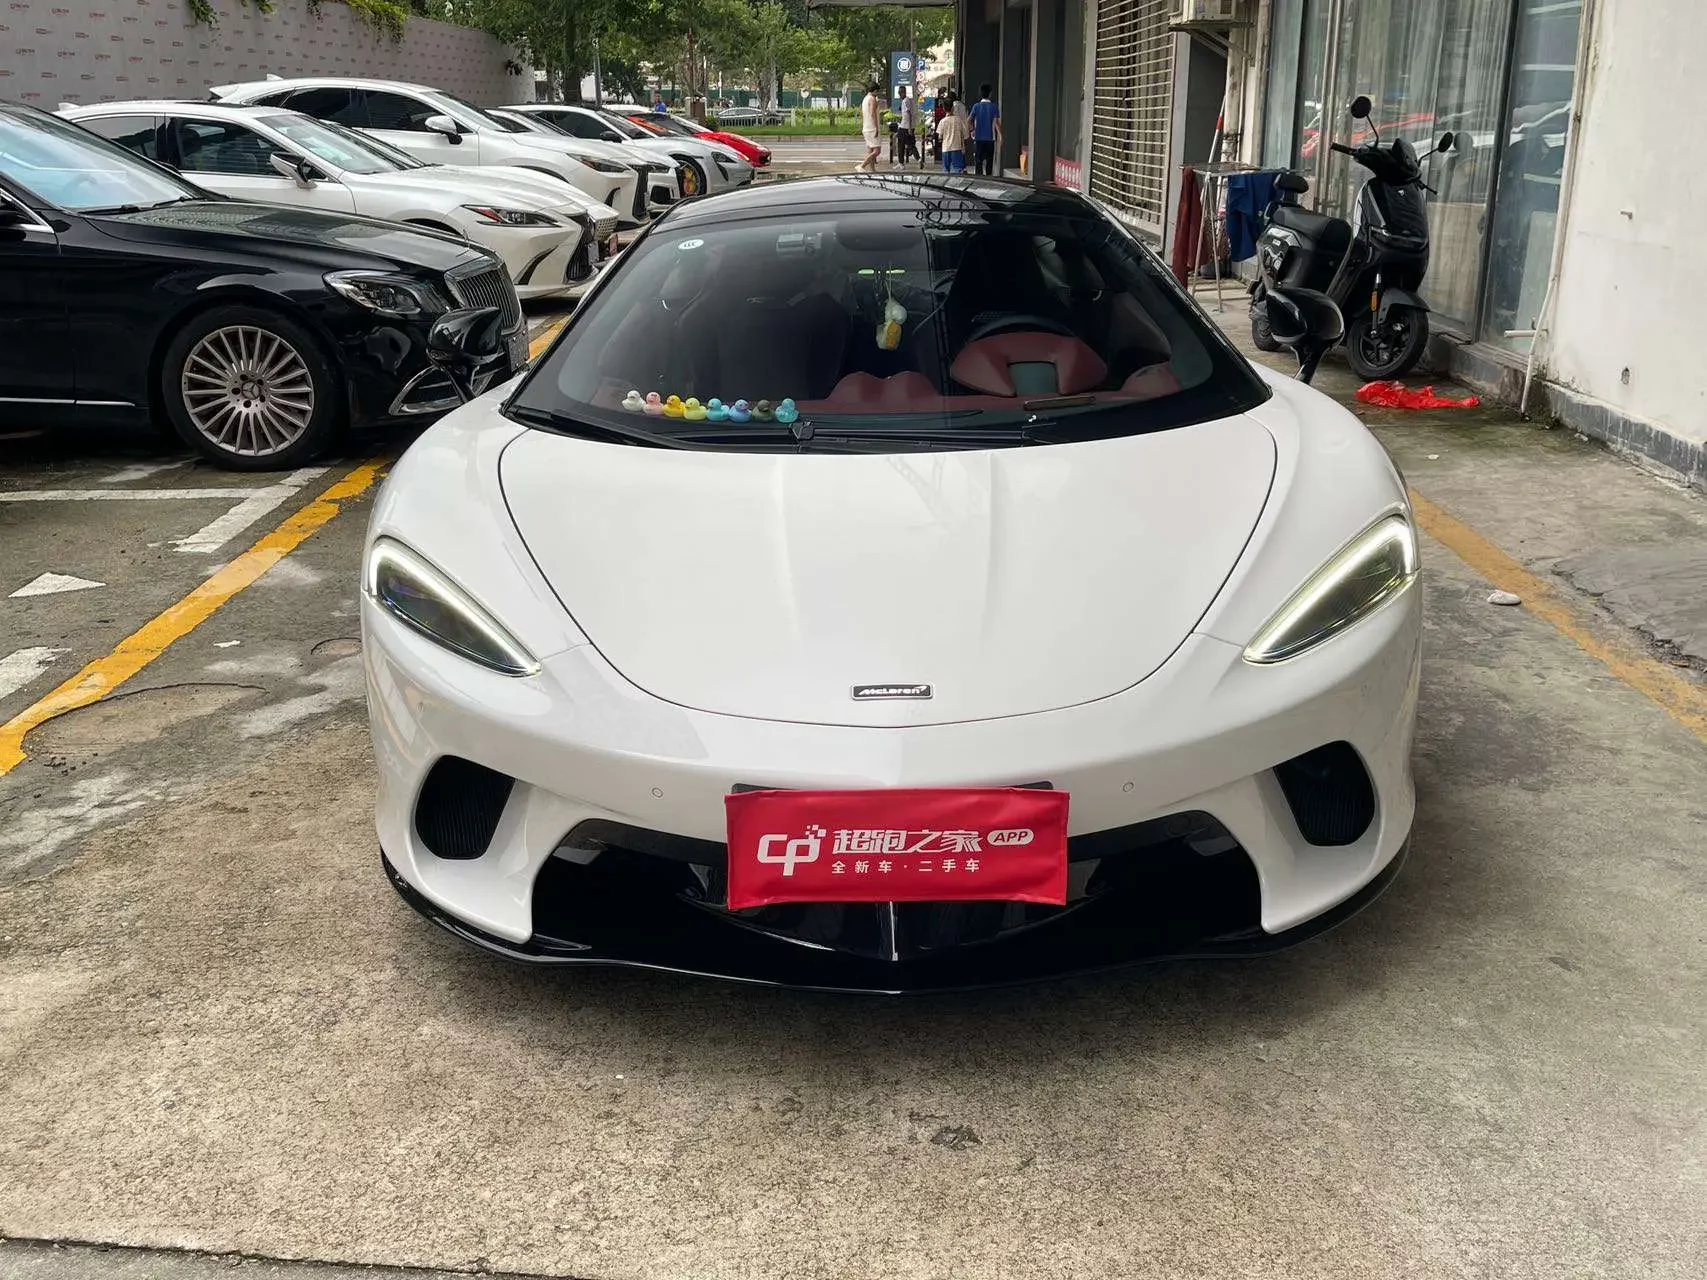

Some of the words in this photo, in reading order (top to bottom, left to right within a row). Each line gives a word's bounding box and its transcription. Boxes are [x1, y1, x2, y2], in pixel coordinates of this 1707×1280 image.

[858, 685, 928, 696] McLaren
[832, 829, 983, 854] 超跑之家
[993, 830, 1029, 843] APP
